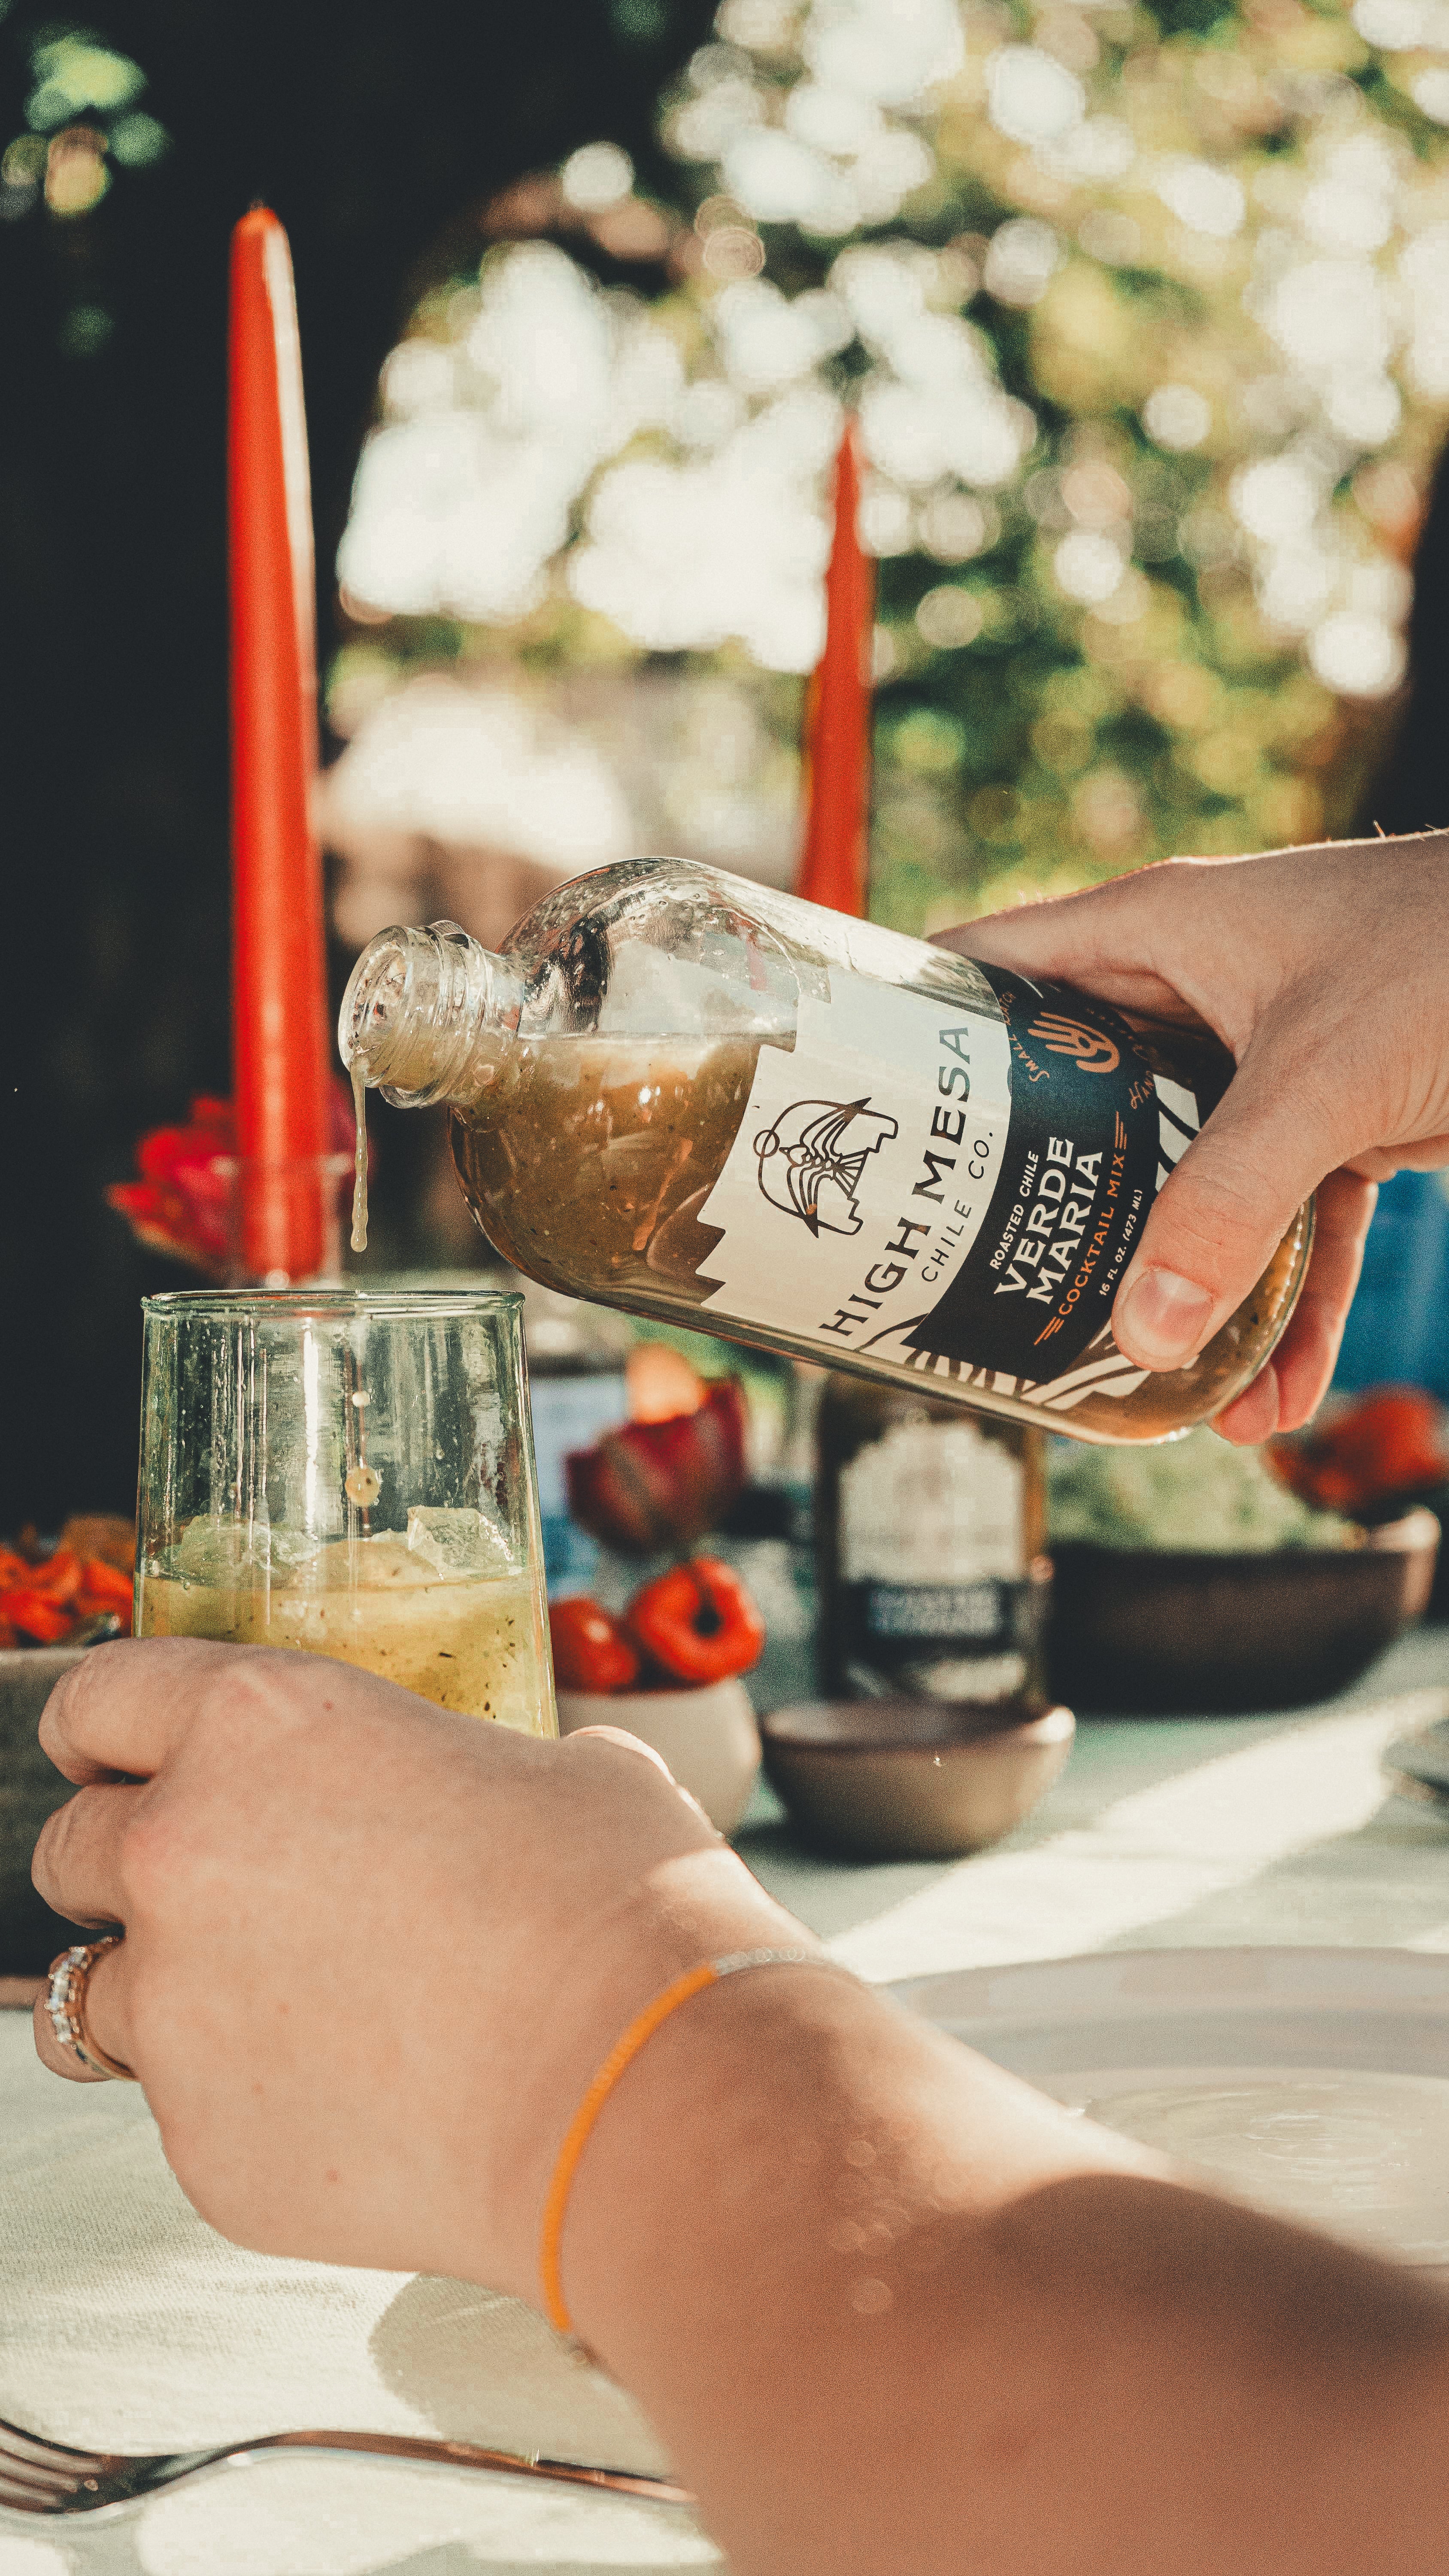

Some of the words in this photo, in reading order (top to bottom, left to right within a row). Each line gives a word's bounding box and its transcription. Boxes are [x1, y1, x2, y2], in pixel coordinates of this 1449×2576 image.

[1008, 1034, 1050, 1082] SMALL
[818, 1217, 931, 1336] HIGH
[912, 1027, 970, 1203] MESA
[921, 1199, 971, 1282] CHILE
[968, 1132, 993, 1179] CO.
[989, 1204, 1024, 1270] ROASTED
[1019, 1151, 1039, 1197] CHILE
[994, 1136, 1074, 1294] VERDE
[1026, 1152, 1103, 1304] MARIA
[1058, 1206, 1115, 1315] COCKTAIL
[1107, 1153, 1125, 1197] MIX
[1099, 1282, 1110, 1296] 16
[1107, 1268, 1118, 1280] FL
[1115, 1246, 1127, 1263] OZ.
[1122, 1213, 1137, 1241] (473
[1132, 1189, 1143, 1210] ML)
